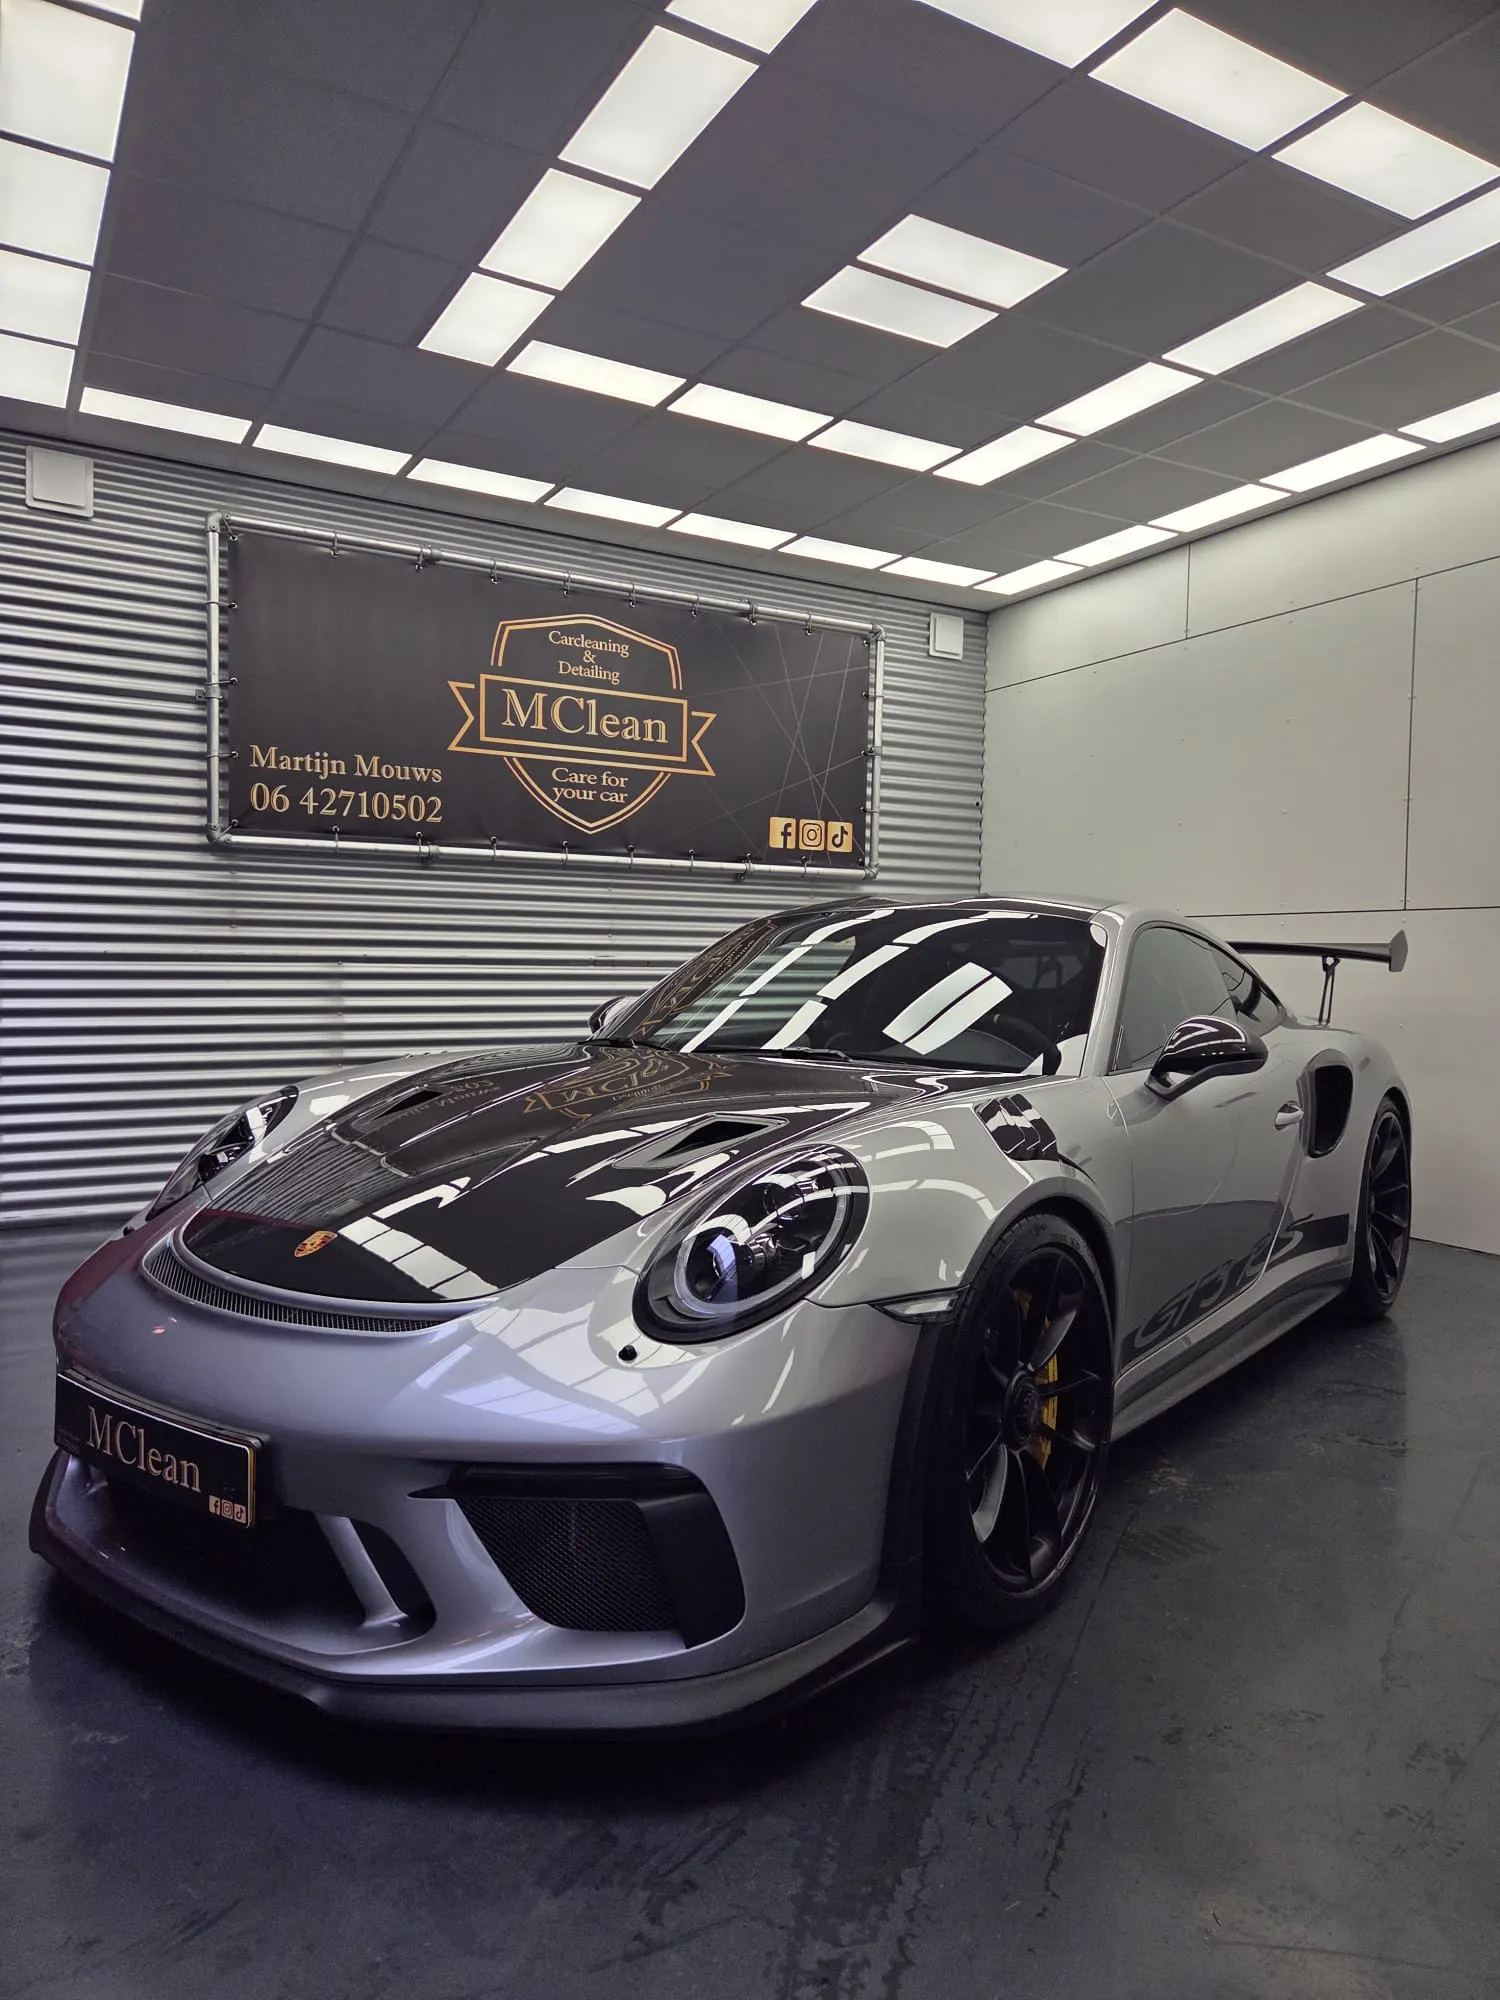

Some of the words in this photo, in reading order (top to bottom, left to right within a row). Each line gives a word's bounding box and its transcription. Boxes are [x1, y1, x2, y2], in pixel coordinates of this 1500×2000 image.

[548, 630, 630, 657] Carcleaning
[582, 650, 597, 664] &
[558, 661, 620, 685] Detailing
[501, 688, 668, 744] MClean
[249, 744, 347, 780] Martijn
[354, 754, 442, 783] Mouws
[551, 767, 597, 785] Care
[601, 770, 628, 788] for
[250, 782, 290, 813] 06
[299, 786, 443, 823] 42710502
[552, 786, 597, 802] your
[599, 788, 628, 803] car
[86, 1405, 202, 1493] MClean
